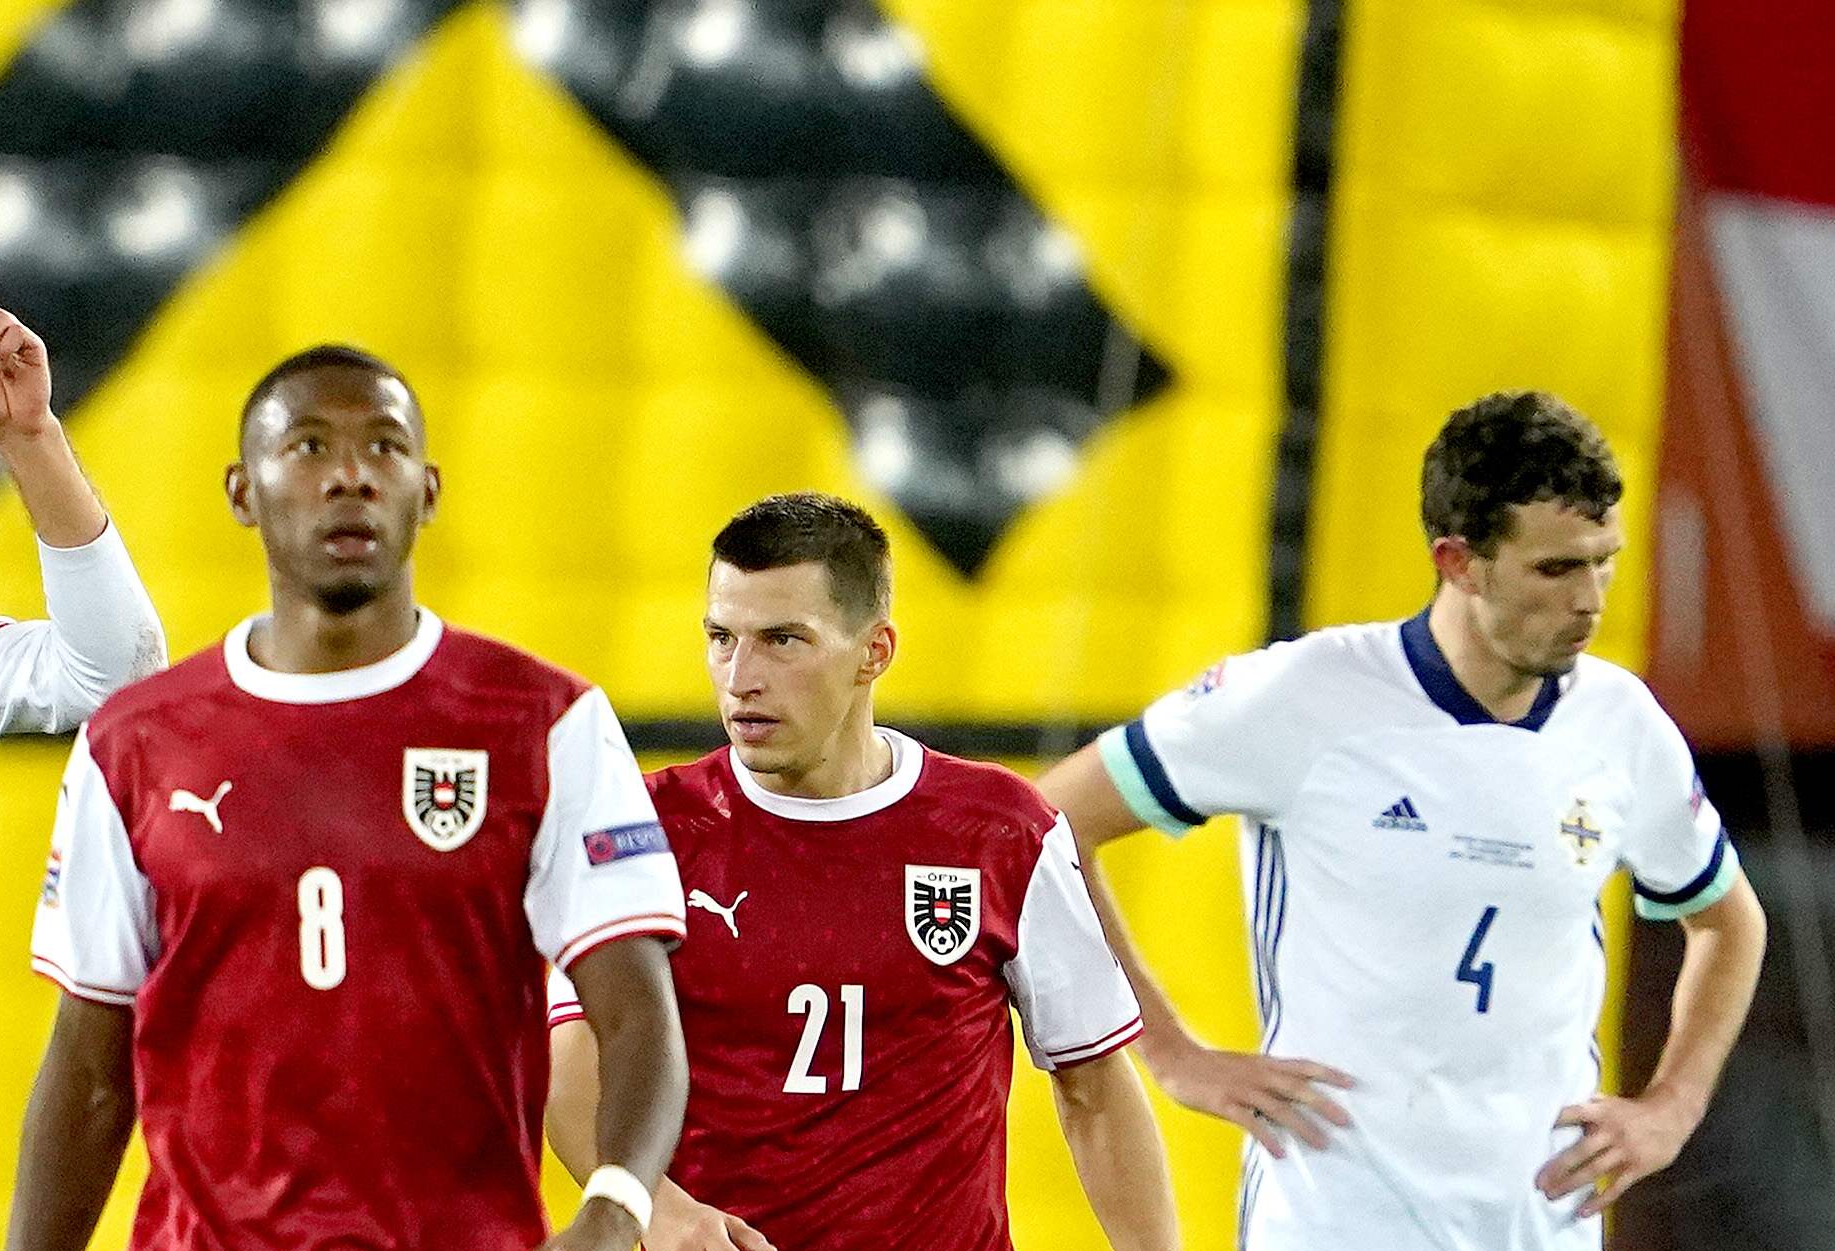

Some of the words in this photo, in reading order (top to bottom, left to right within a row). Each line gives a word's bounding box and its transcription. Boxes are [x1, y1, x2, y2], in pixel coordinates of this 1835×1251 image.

[297, 867, 346, 990] 8
[1456, 906, 1498, 1013] 4
[782, 983, 864, 1095] 21
